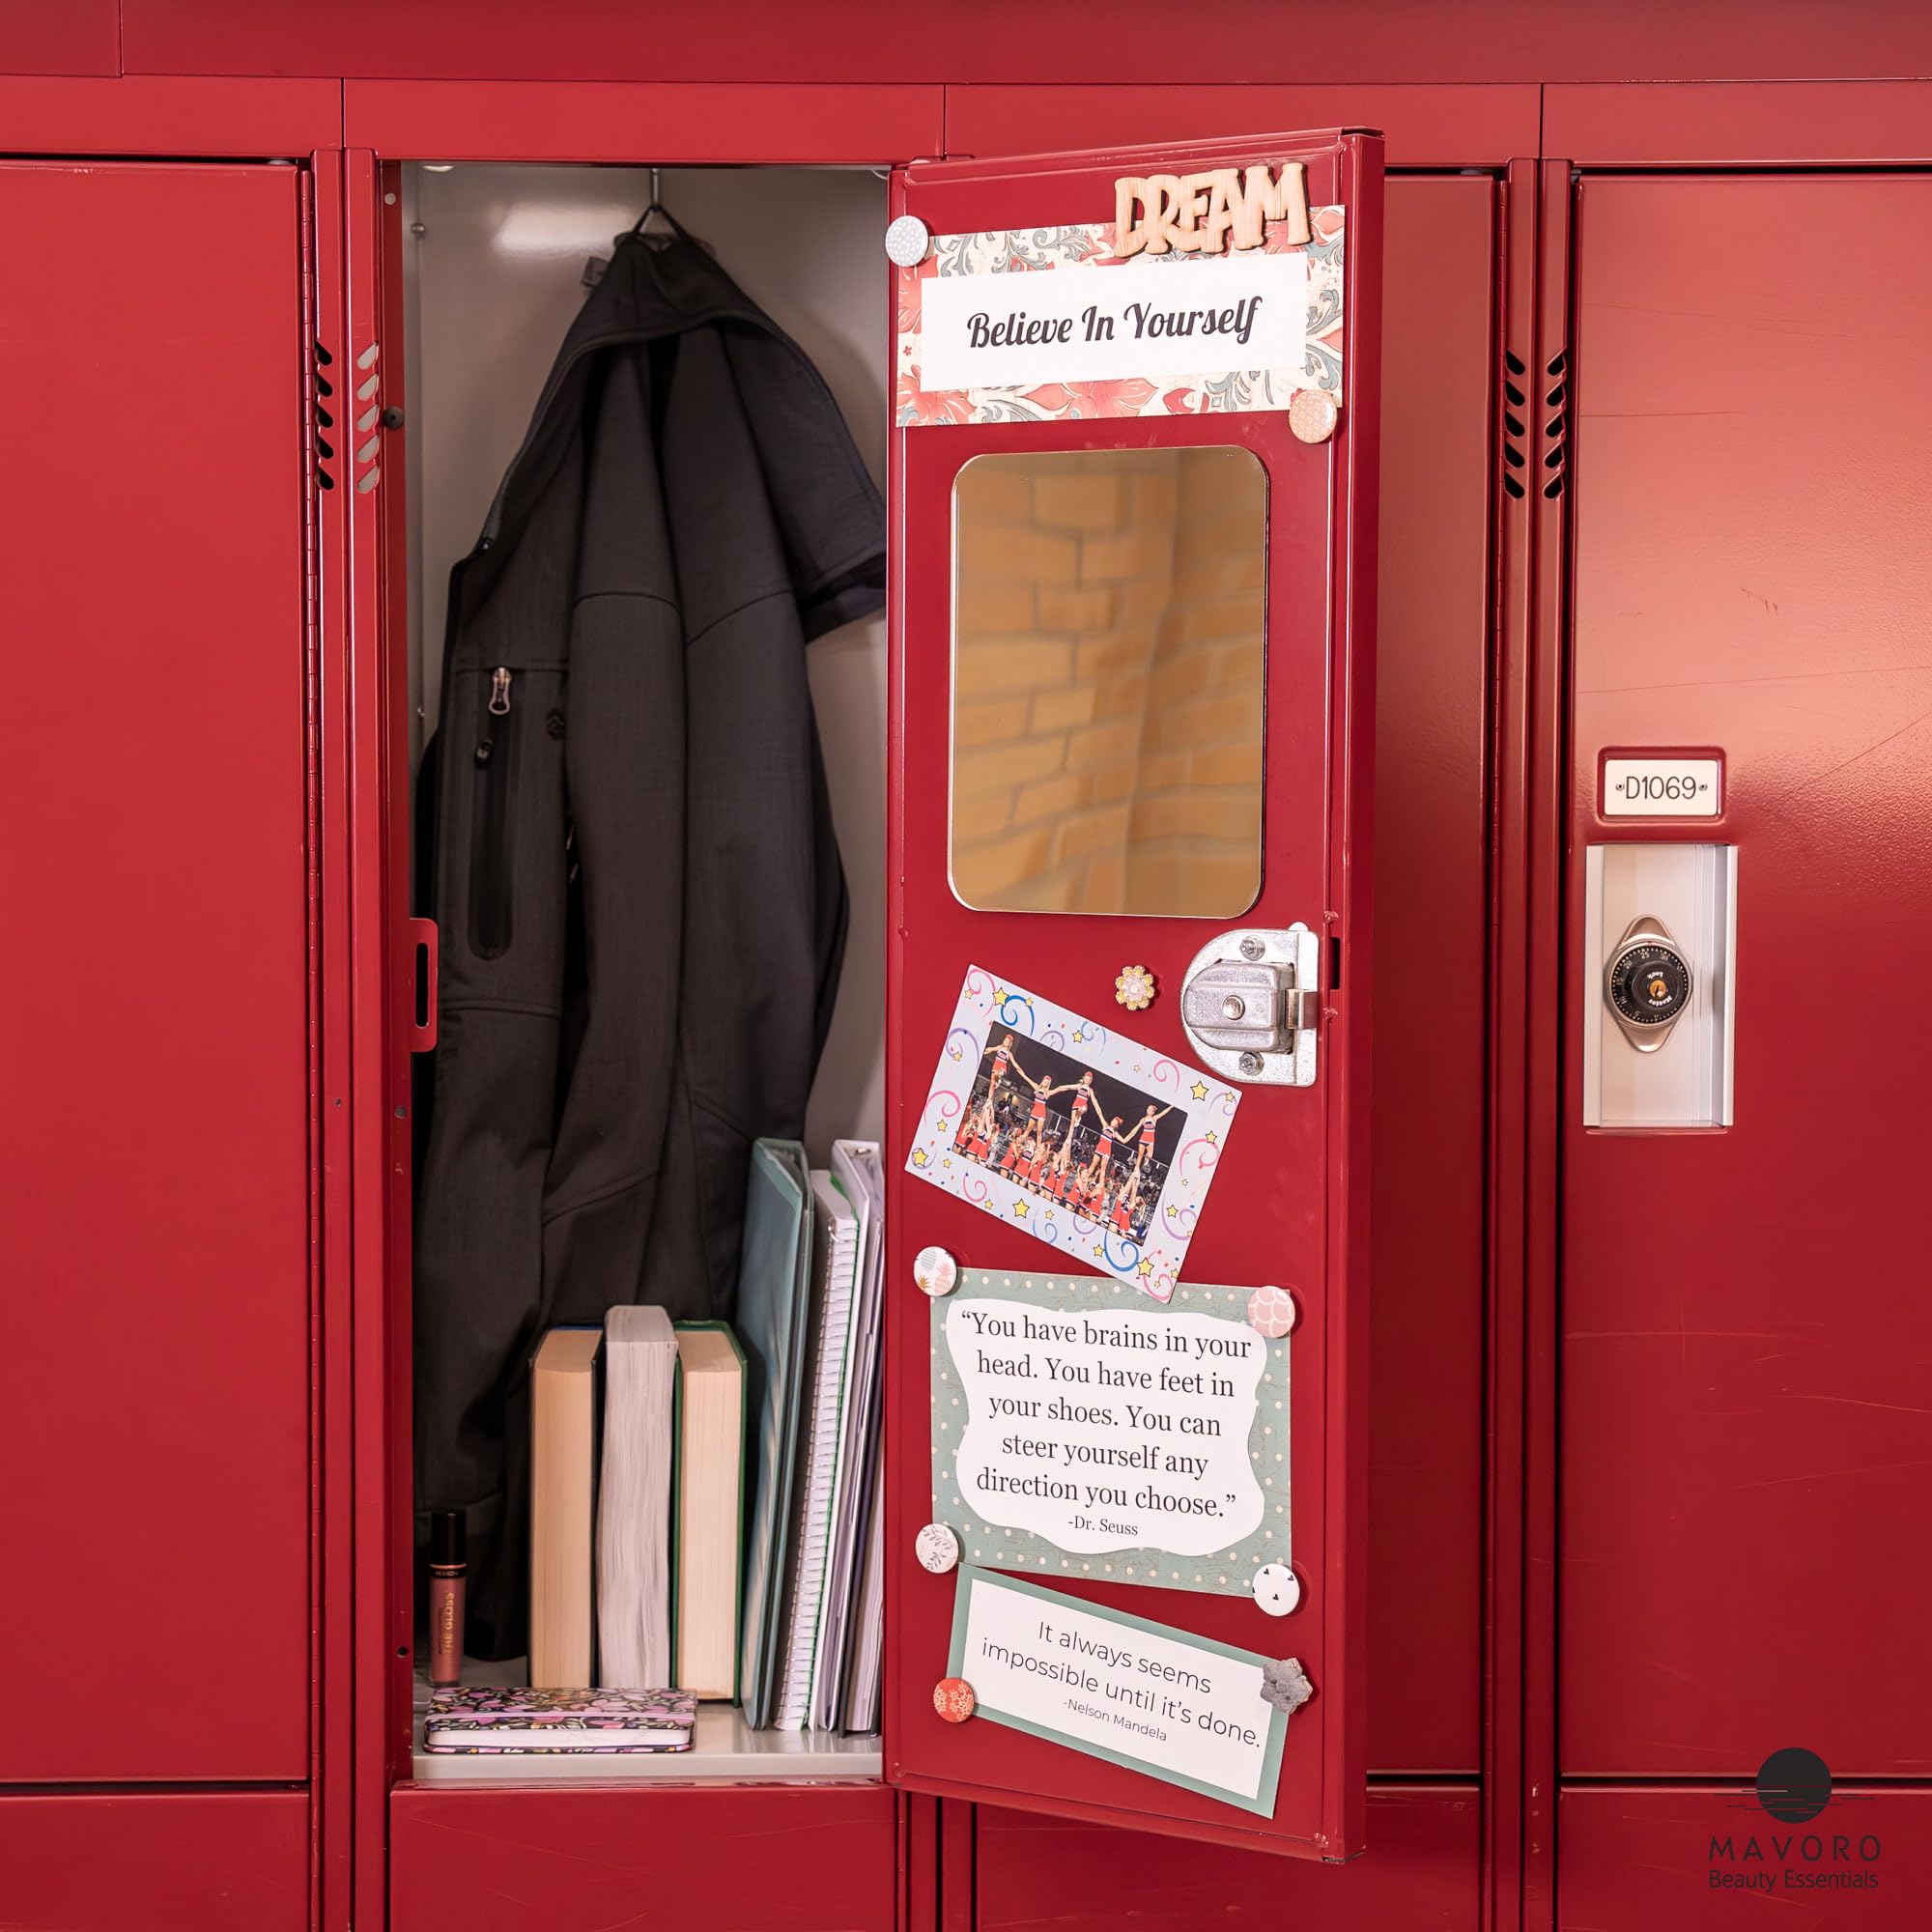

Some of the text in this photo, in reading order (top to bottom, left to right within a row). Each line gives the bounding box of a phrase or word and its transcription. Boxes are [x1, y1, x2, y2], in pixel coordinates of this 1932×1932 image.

[1114, 162, 1310, 257] DREAM
[967, 297, 1263, 348] Believe In Yourself
[1625, 776, 1696, 799] D1069
[962, 1311, 1251, 1360] “You have brains in your
[978, 1350, 1234, 1397] head. You have feet in
[989, 1397, 1221, 1435] your shoes. You can
[1003, 1435, 1208, 1480] steer yourself any
[978, 1467, 1236, 1517] direction you choose.”
[1067, 1516, 1137, 1535] -Dr. Seuss
[444, 1592, 454, 1655] THE GLOSS
[1039, 1622, 1210, 1693] It always seems
[983, 1637, 1259, 1747] impossible until it’s done.
[1063, 1699, 1166, 1741] -Nelson Mandela
